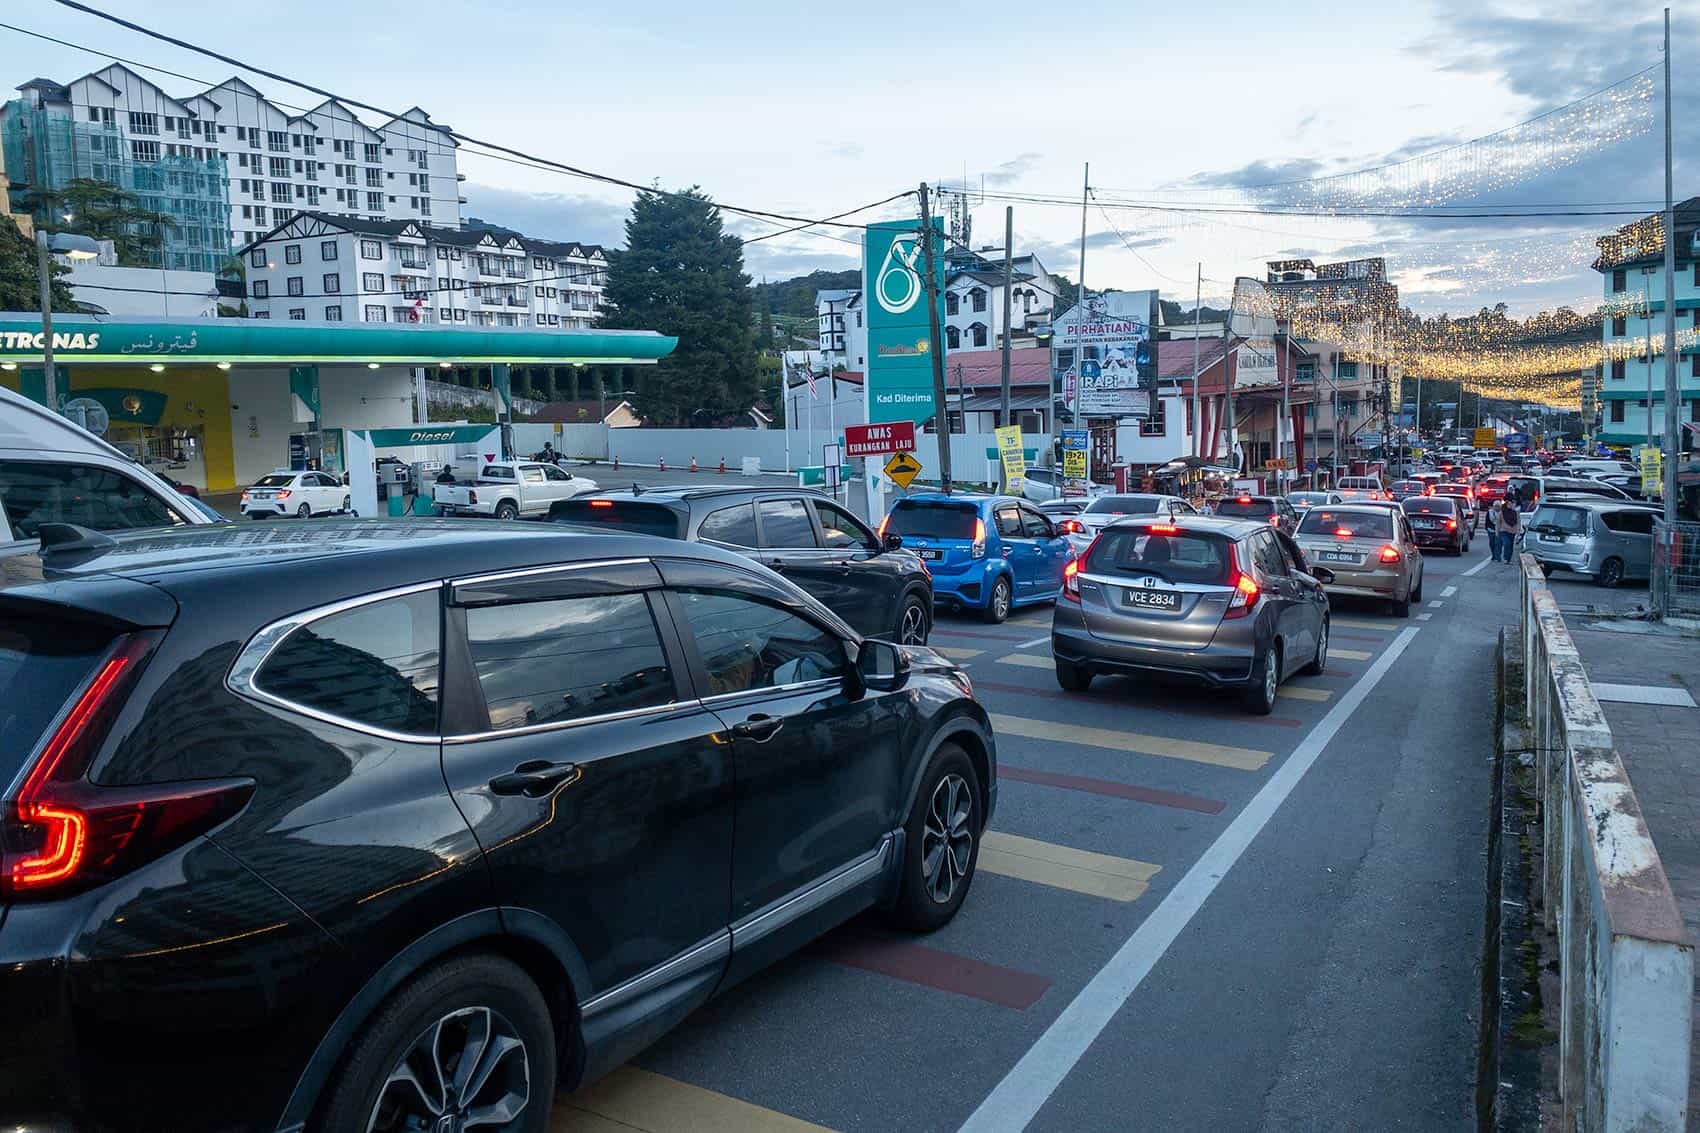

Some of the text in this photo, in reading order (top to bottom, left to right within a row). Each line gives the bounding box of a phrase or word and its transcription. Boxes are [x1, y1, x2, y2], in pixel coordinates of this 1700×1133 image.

[0, 331, 100, 349] TRONAS
[877, 393, 931, 403] Kad Diterima
[410, 431, 456, 442] Diesel
[867, 427, 892, 441] AWAS
[849, 440, 912, 453] KURANGKAN LAJU
[1129, 591, 1175, 605] VCE 2834
